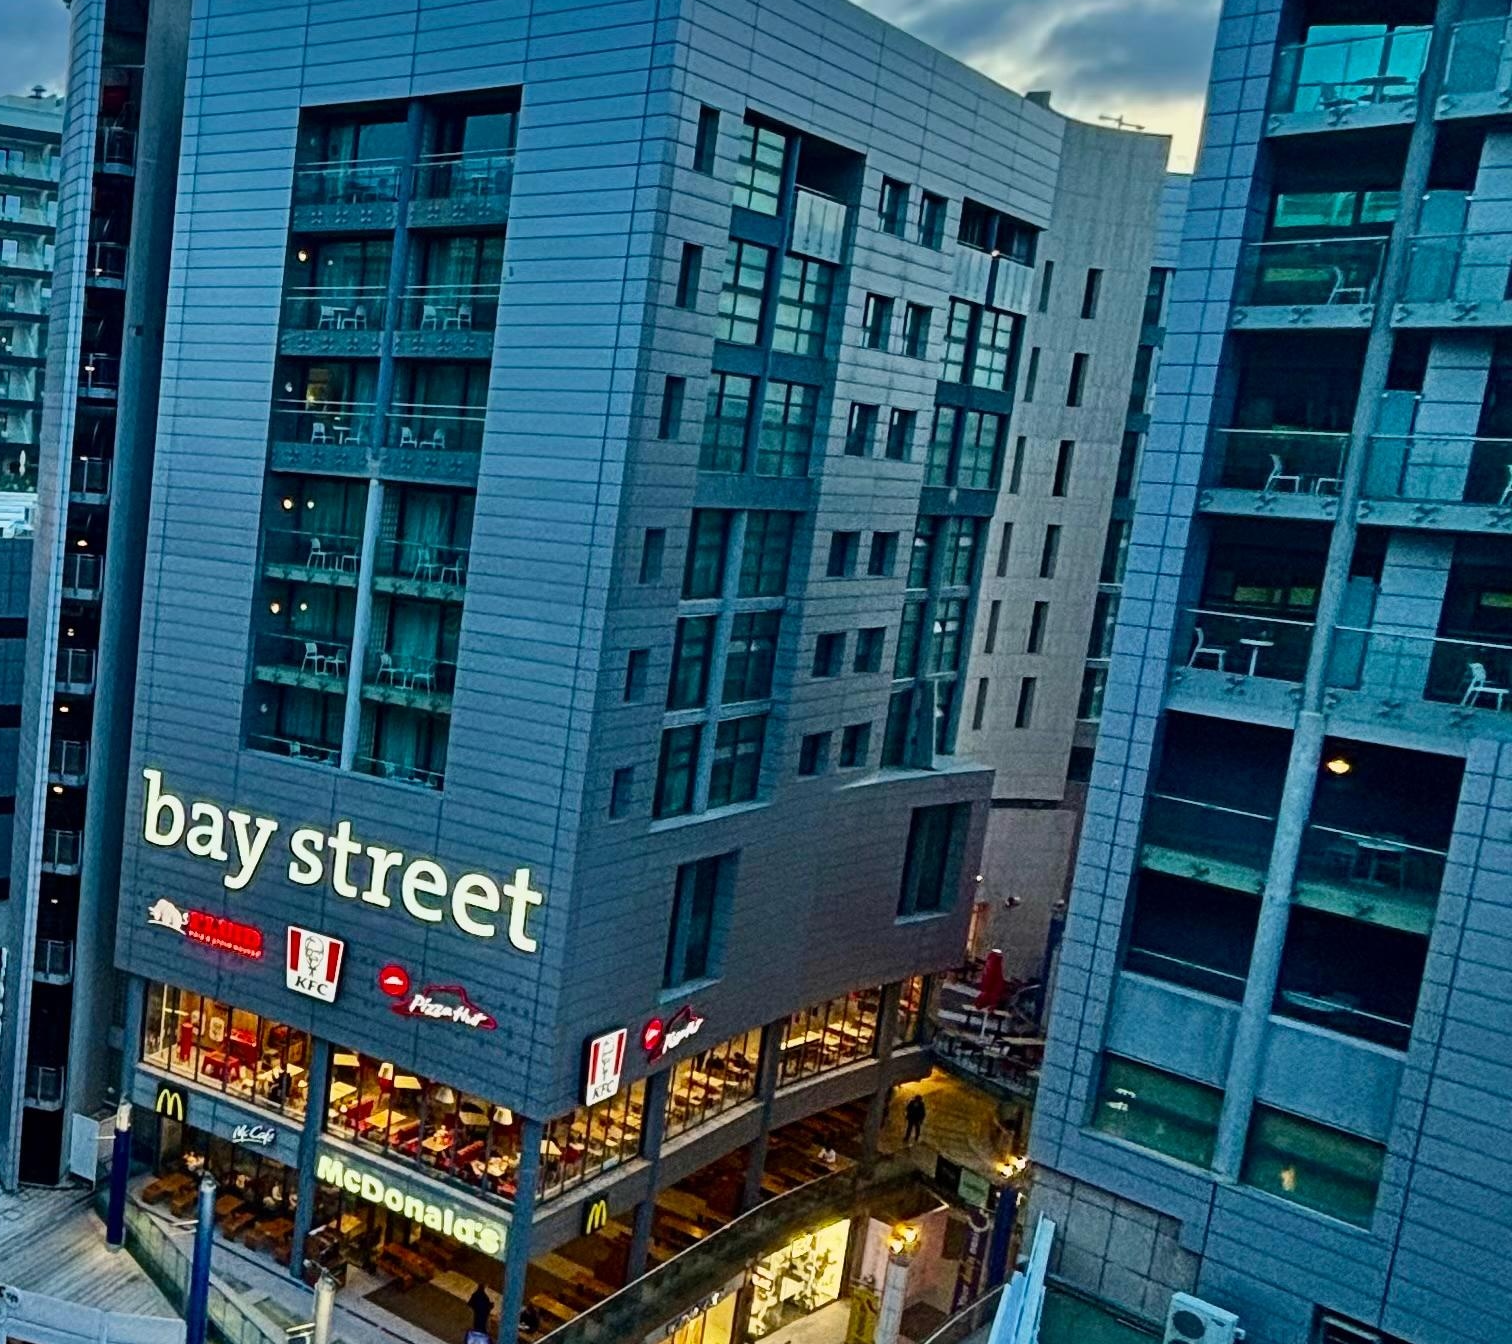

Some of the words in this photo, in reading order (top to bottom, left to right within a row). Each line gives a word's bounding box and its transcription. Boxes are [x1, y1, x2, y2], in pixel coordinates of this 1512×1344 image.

[143, 768, 279, 891] bay
[288, 820, 544, 954] street
[294, 975, 329, 997] KFC
[408, 994, 453, 1018] Pizza
[591, 1079, 615, 1100] KFC
[316, 1154, 503, 1256] McDonald's
